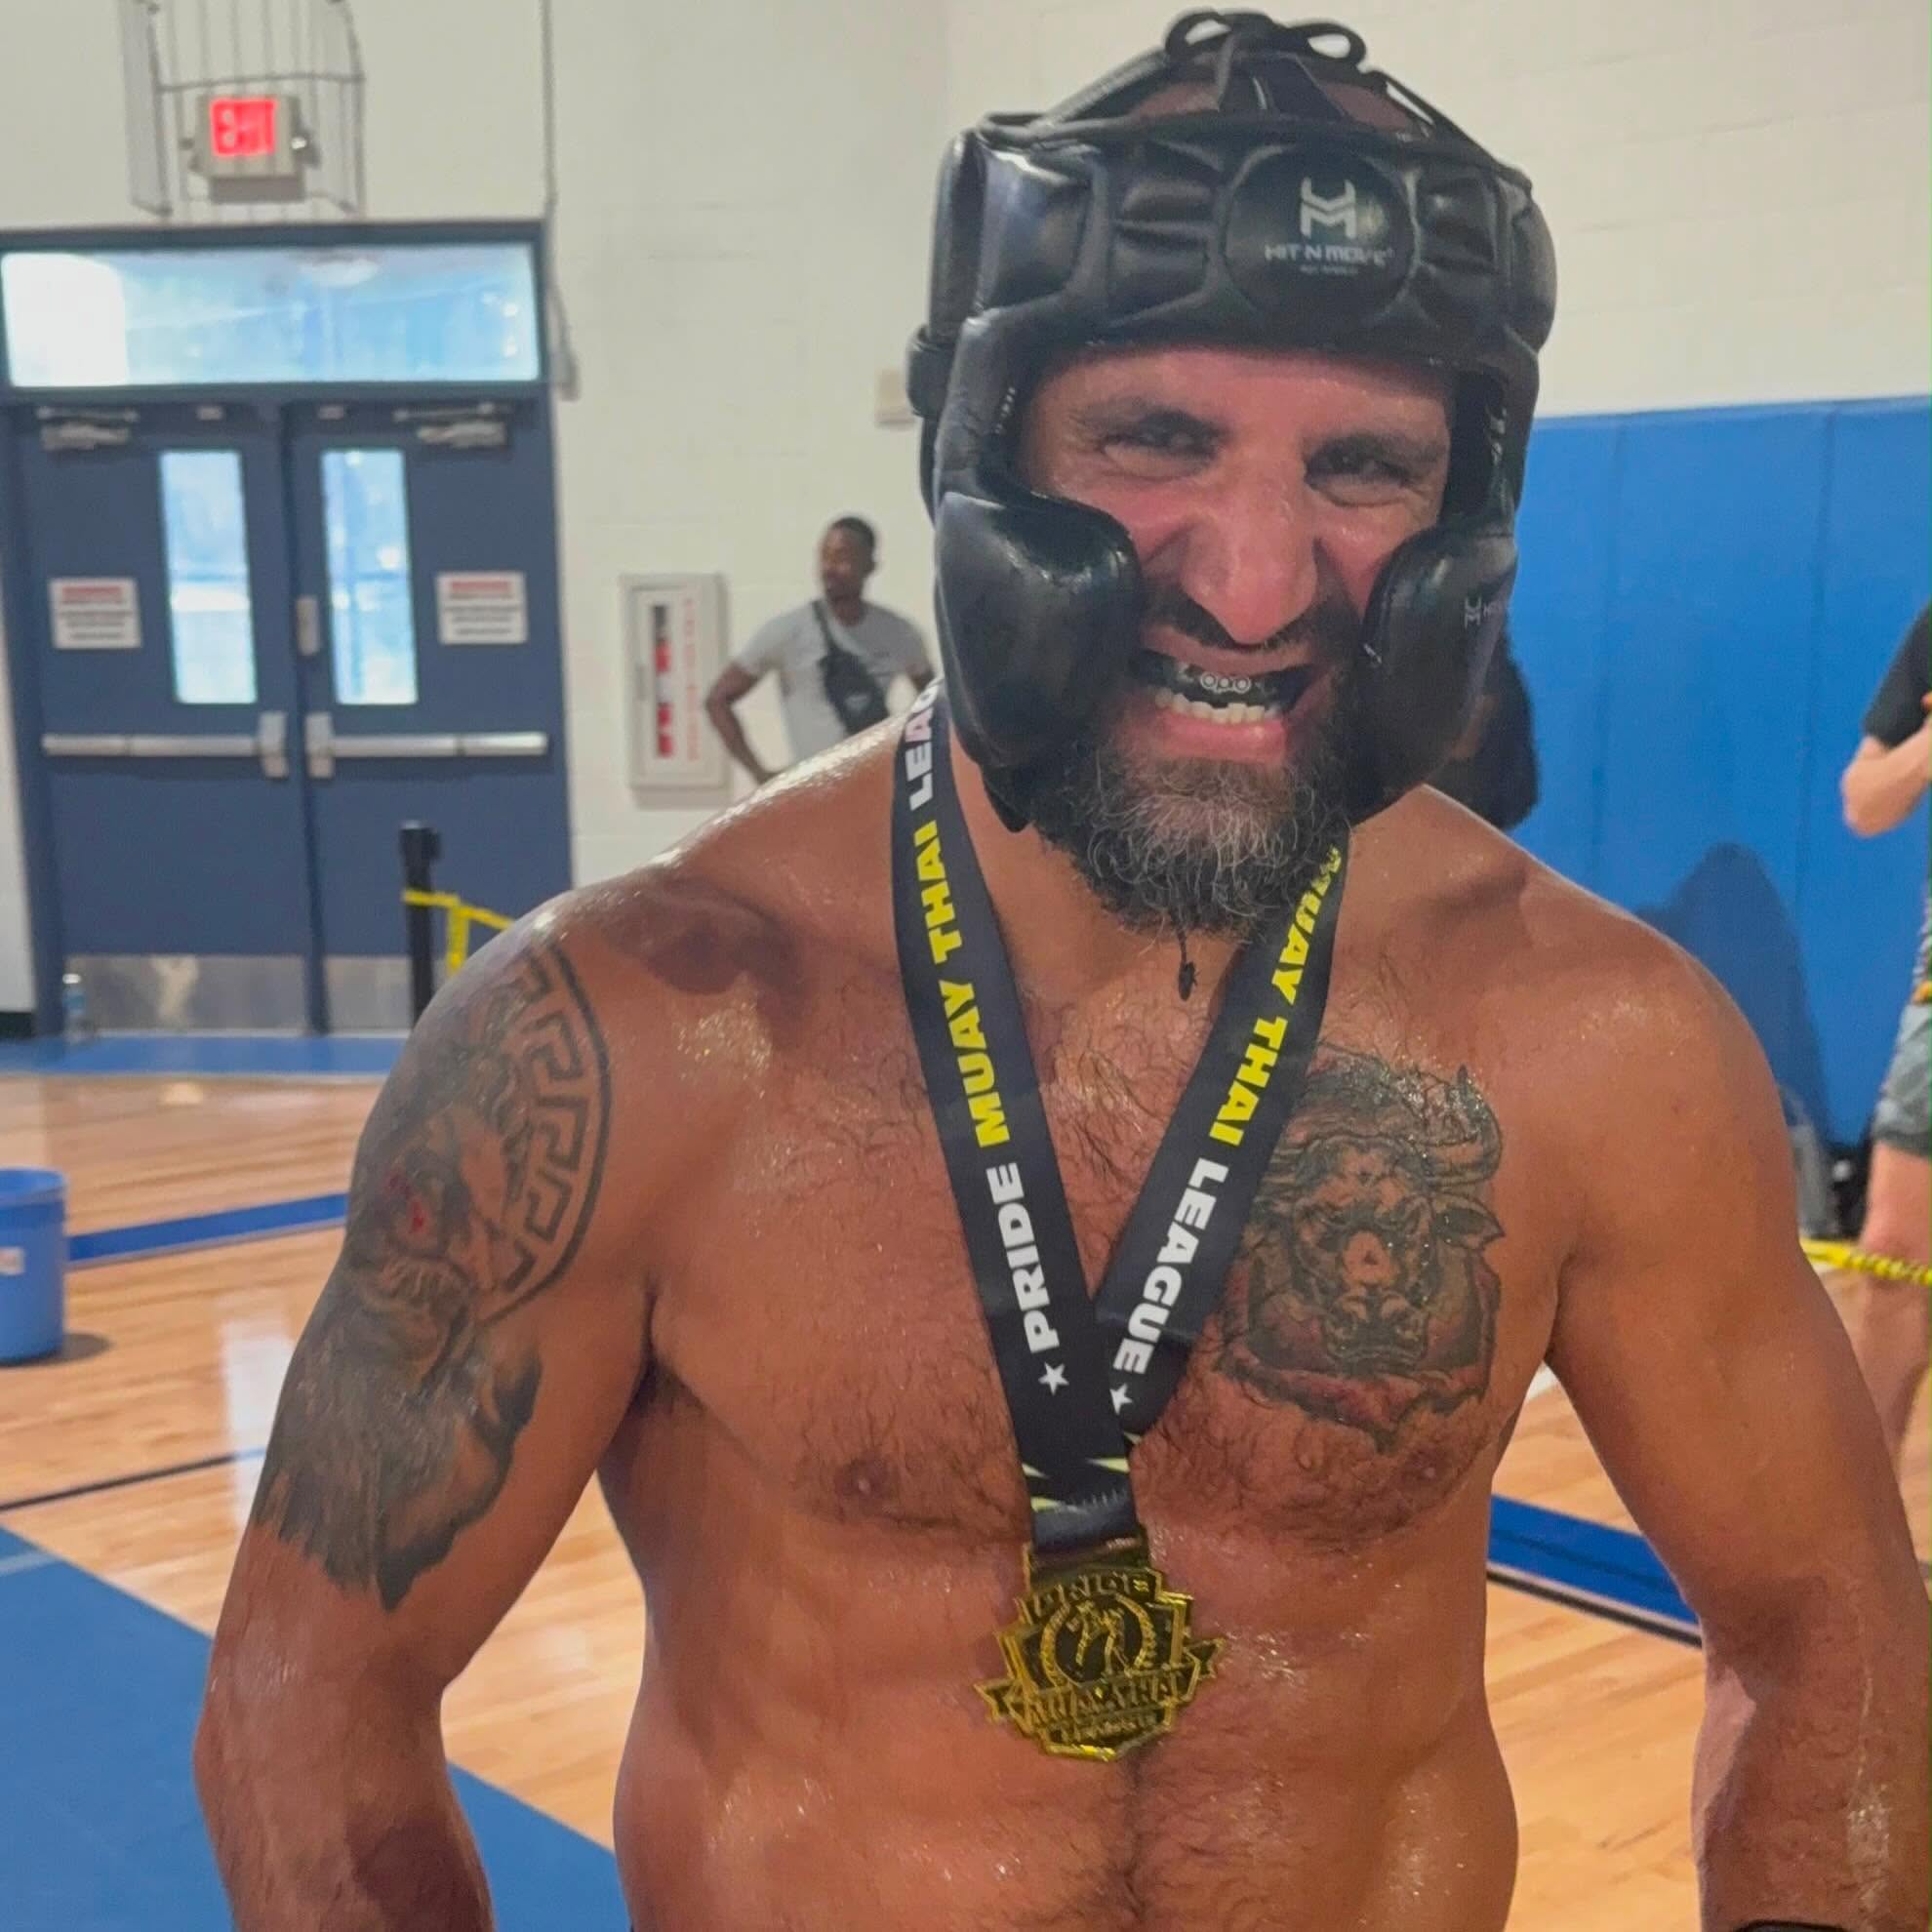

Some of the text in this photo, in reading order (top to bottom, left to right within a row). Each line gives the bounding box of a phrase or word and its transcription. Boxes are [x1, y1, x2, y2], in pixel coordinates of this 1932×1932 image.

[1265, 244, 1299, 261] HIT
[1304, 244, 1322, 261] N
[913, 819, 963, 965] THAI
[939, 979, 1011, 1148] MUAY
[1209, 1017, 1288, 1147] THAI
[986, 1162, 1061, 1354] PRIDE
[1112, 1157, 1229, 1375] LEAGUE
